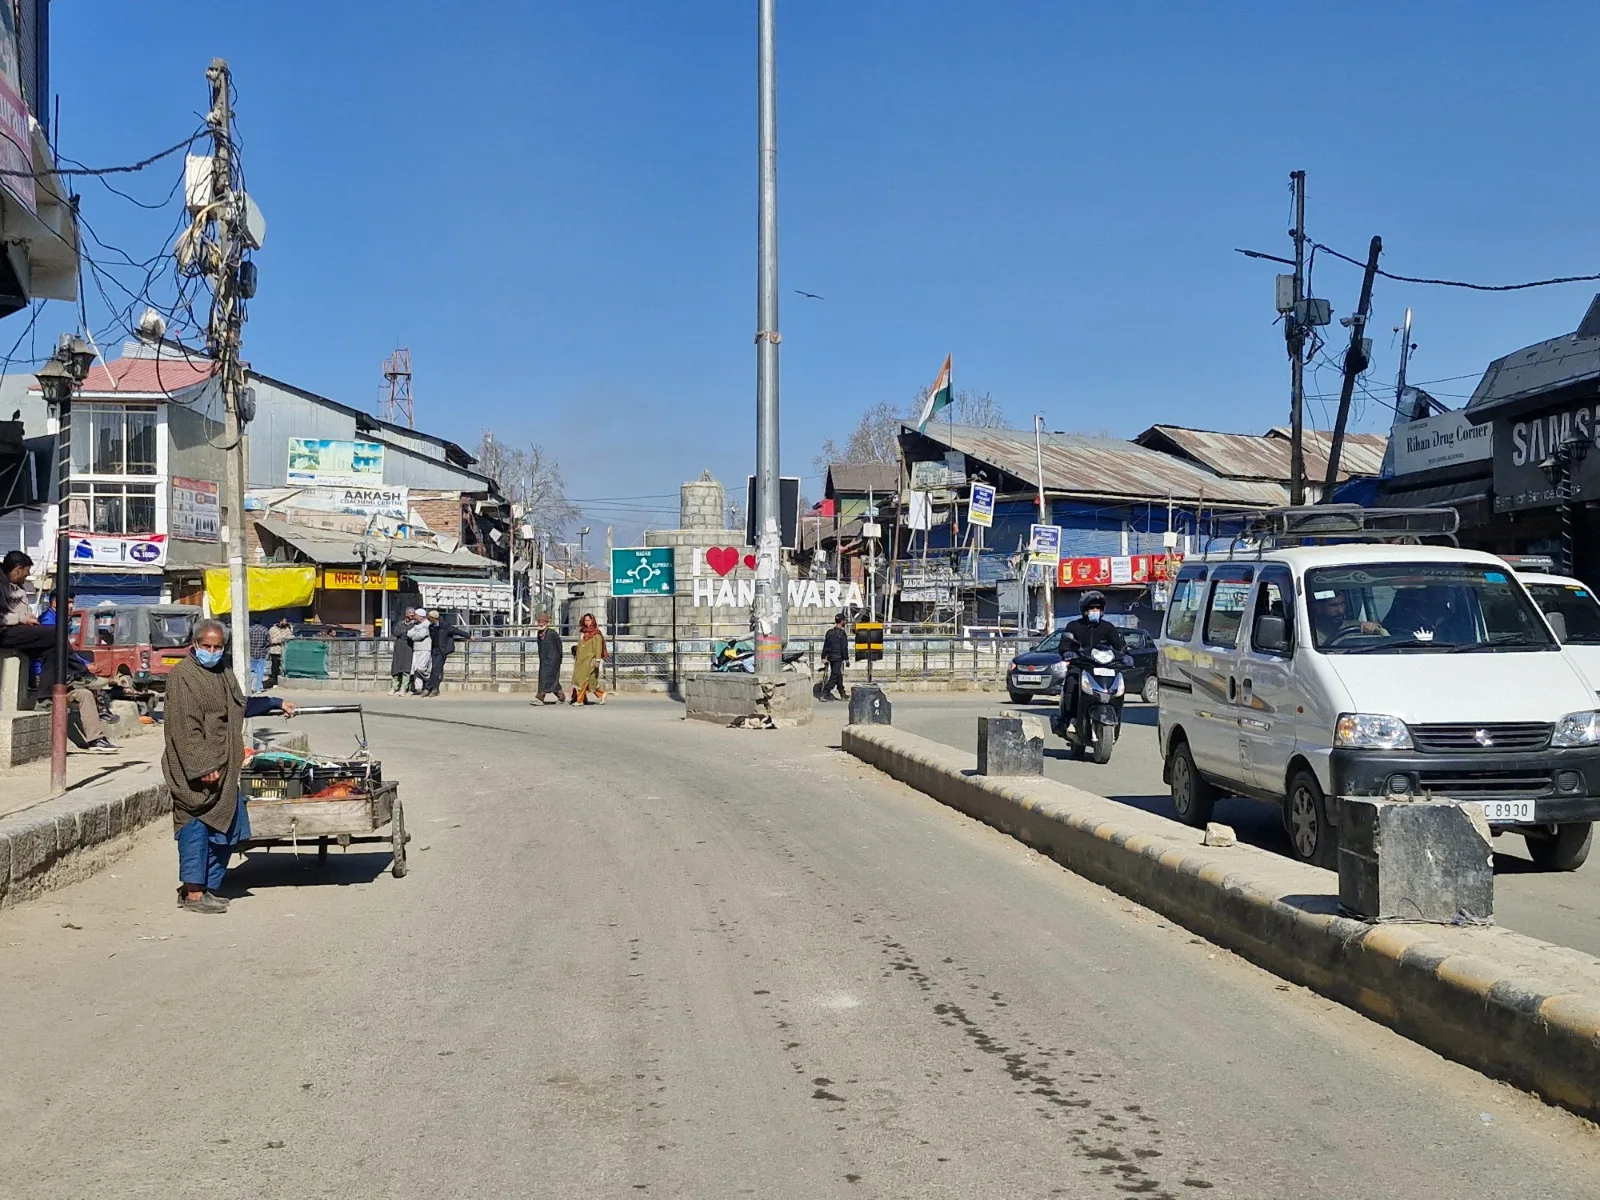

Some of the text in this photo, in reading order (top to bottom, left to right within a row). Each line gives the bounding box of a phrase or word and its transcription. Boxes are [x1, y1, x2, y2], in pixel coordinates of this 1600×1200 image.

[1407, 424, 1489, 453] Rihan Drug Corner
[344, 490, 401, 501] AAKASH
[693, 577, 864, 608] HANWARA
[1495, 803, 1528, 817] 8930
